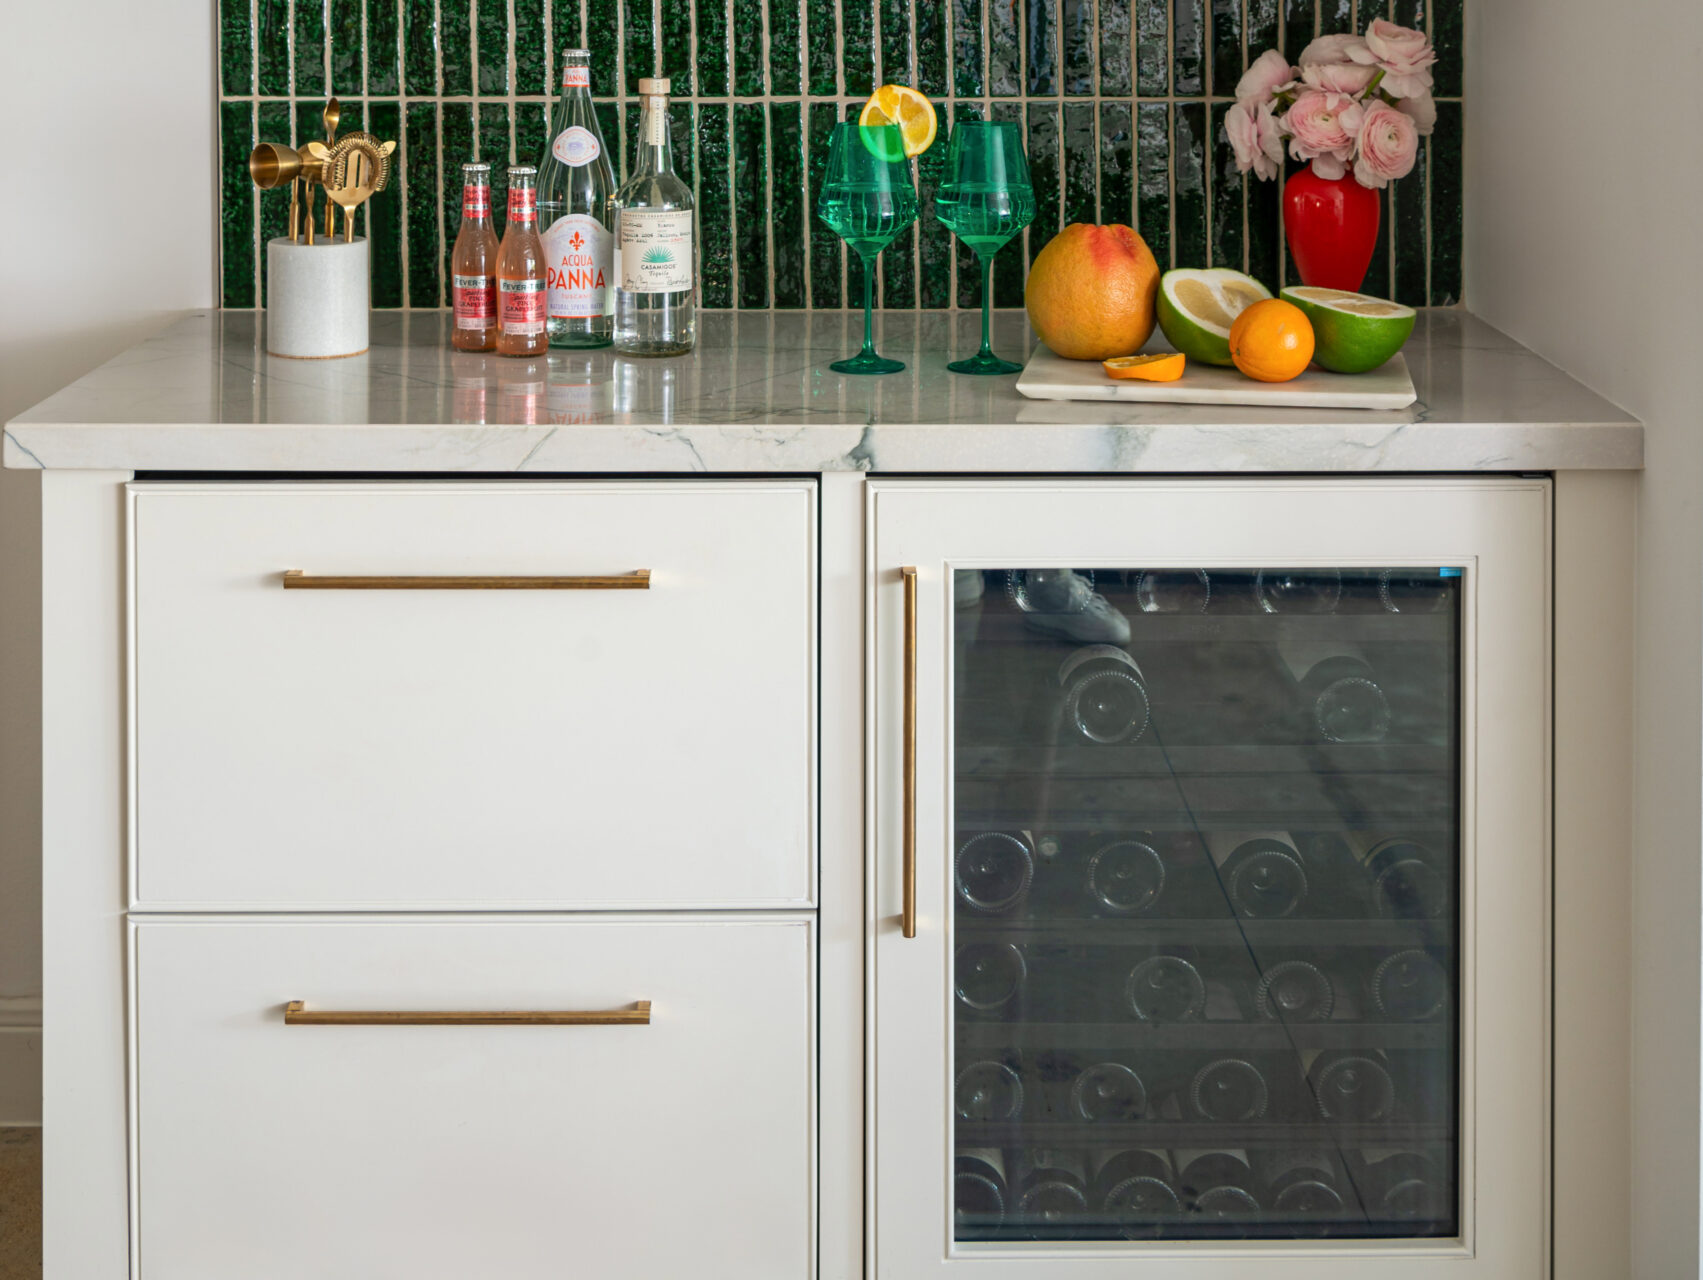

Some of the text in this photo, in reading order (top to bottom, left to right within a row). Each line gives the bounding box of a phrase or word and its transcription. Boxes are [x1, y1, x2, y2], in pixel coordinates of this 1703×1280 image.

[565, 74, 588, 83] PANNA
[561, 254, 593, 266] ACQUA
[455, 277, 496, 287] FEVER-TR
[547, 266, 606, 290] PANNA
